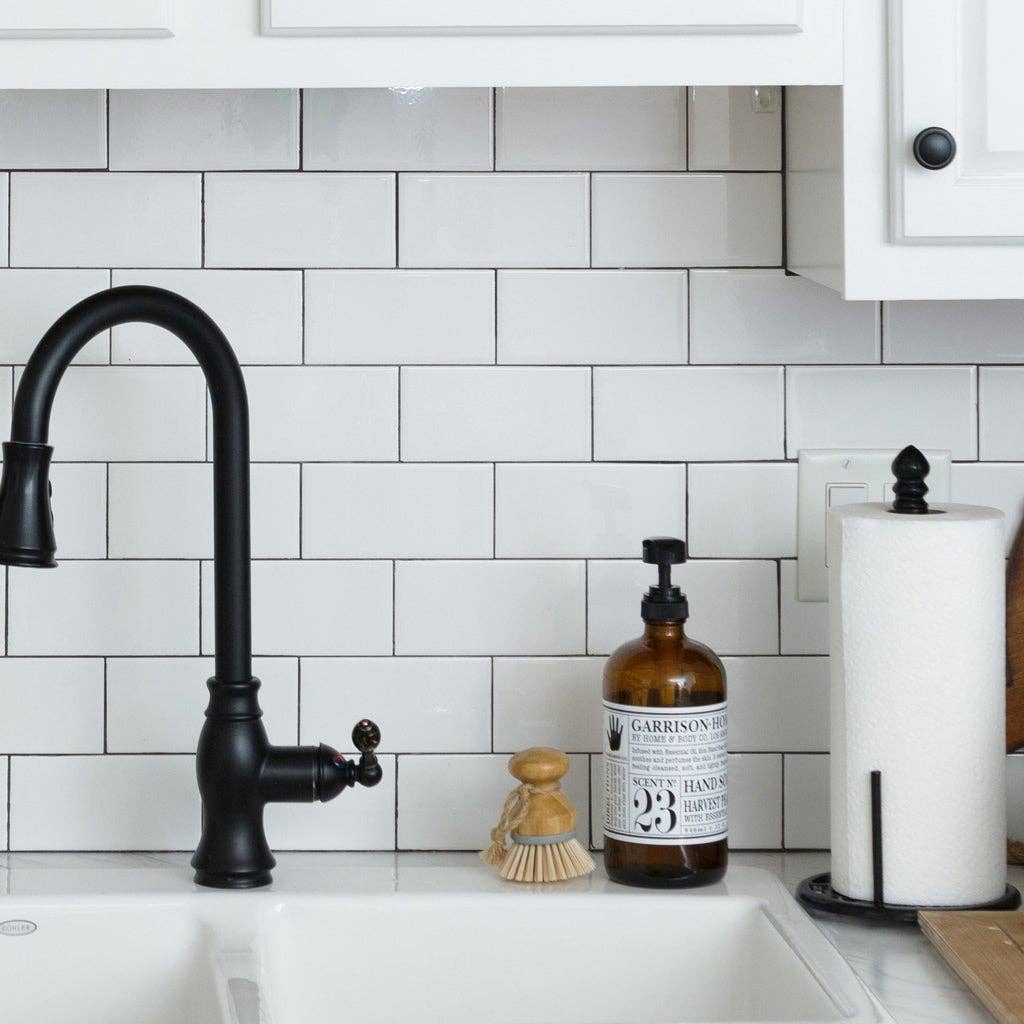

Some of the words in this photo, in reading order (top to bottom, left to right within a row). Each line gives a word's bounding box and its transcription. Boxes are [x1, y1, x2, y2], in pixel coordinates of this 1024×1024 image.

[631, 719, 708, 733] GARRISON
[631, 733, 640, 742] BY
[643, 735, 666, 743] HOME
[668, 735, 674, 743] &
[678, 735, 697, 743] BODY
[632, 777, 665, 788] SCENT
[684, 775, 718, 793] HAND
[634, 788, 677, 834] 23
[684, 795, 720, 813] HARVEST
[684, 814, 704, 823] WITH
